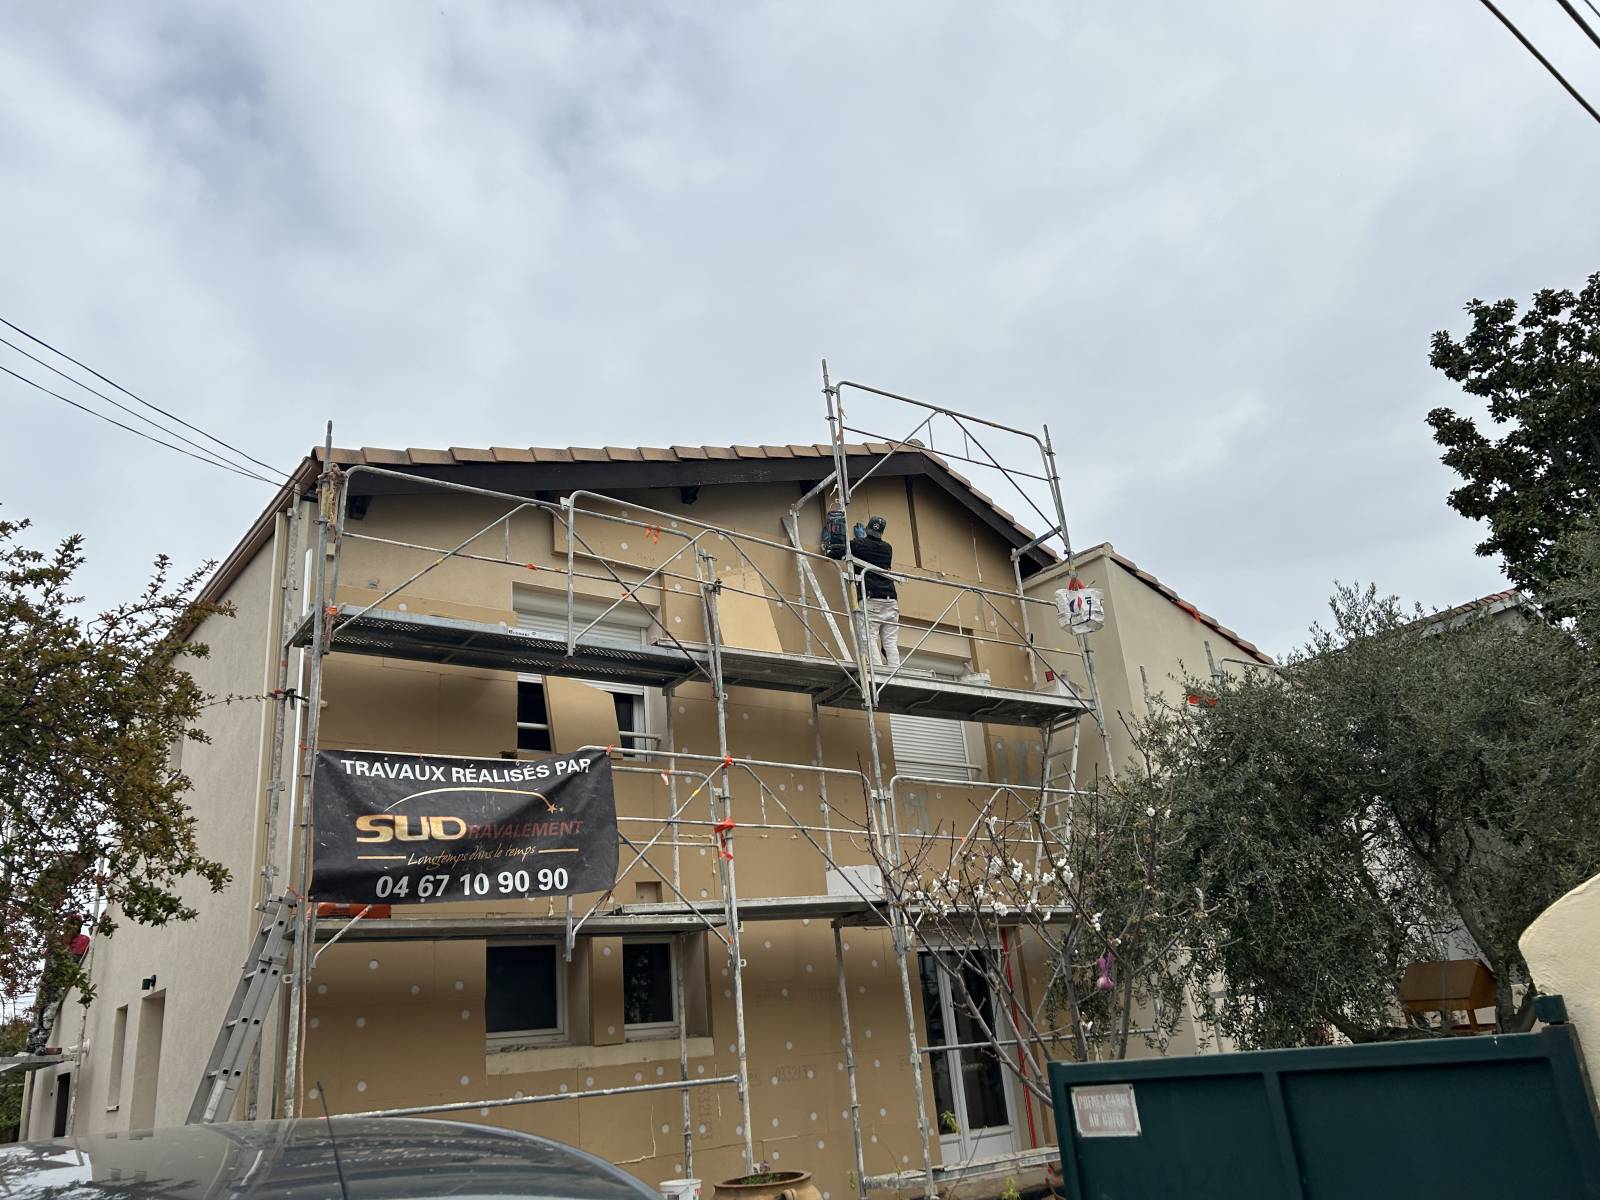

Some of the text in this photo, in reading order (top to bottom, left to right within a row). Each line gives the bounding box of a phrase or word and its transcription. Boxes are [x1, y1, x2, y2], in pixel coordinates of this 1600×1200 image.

[341, 758, 592, 783] TRAVAUX RÉALISÉS PAR
[356, 814, 584, 843] SUD RAVALEMENT
[407, 849, 467, 870] Longtemps
[505, 844, 537, 862] temps
[375, 867, 569, 898] 04 67 10 90 90
